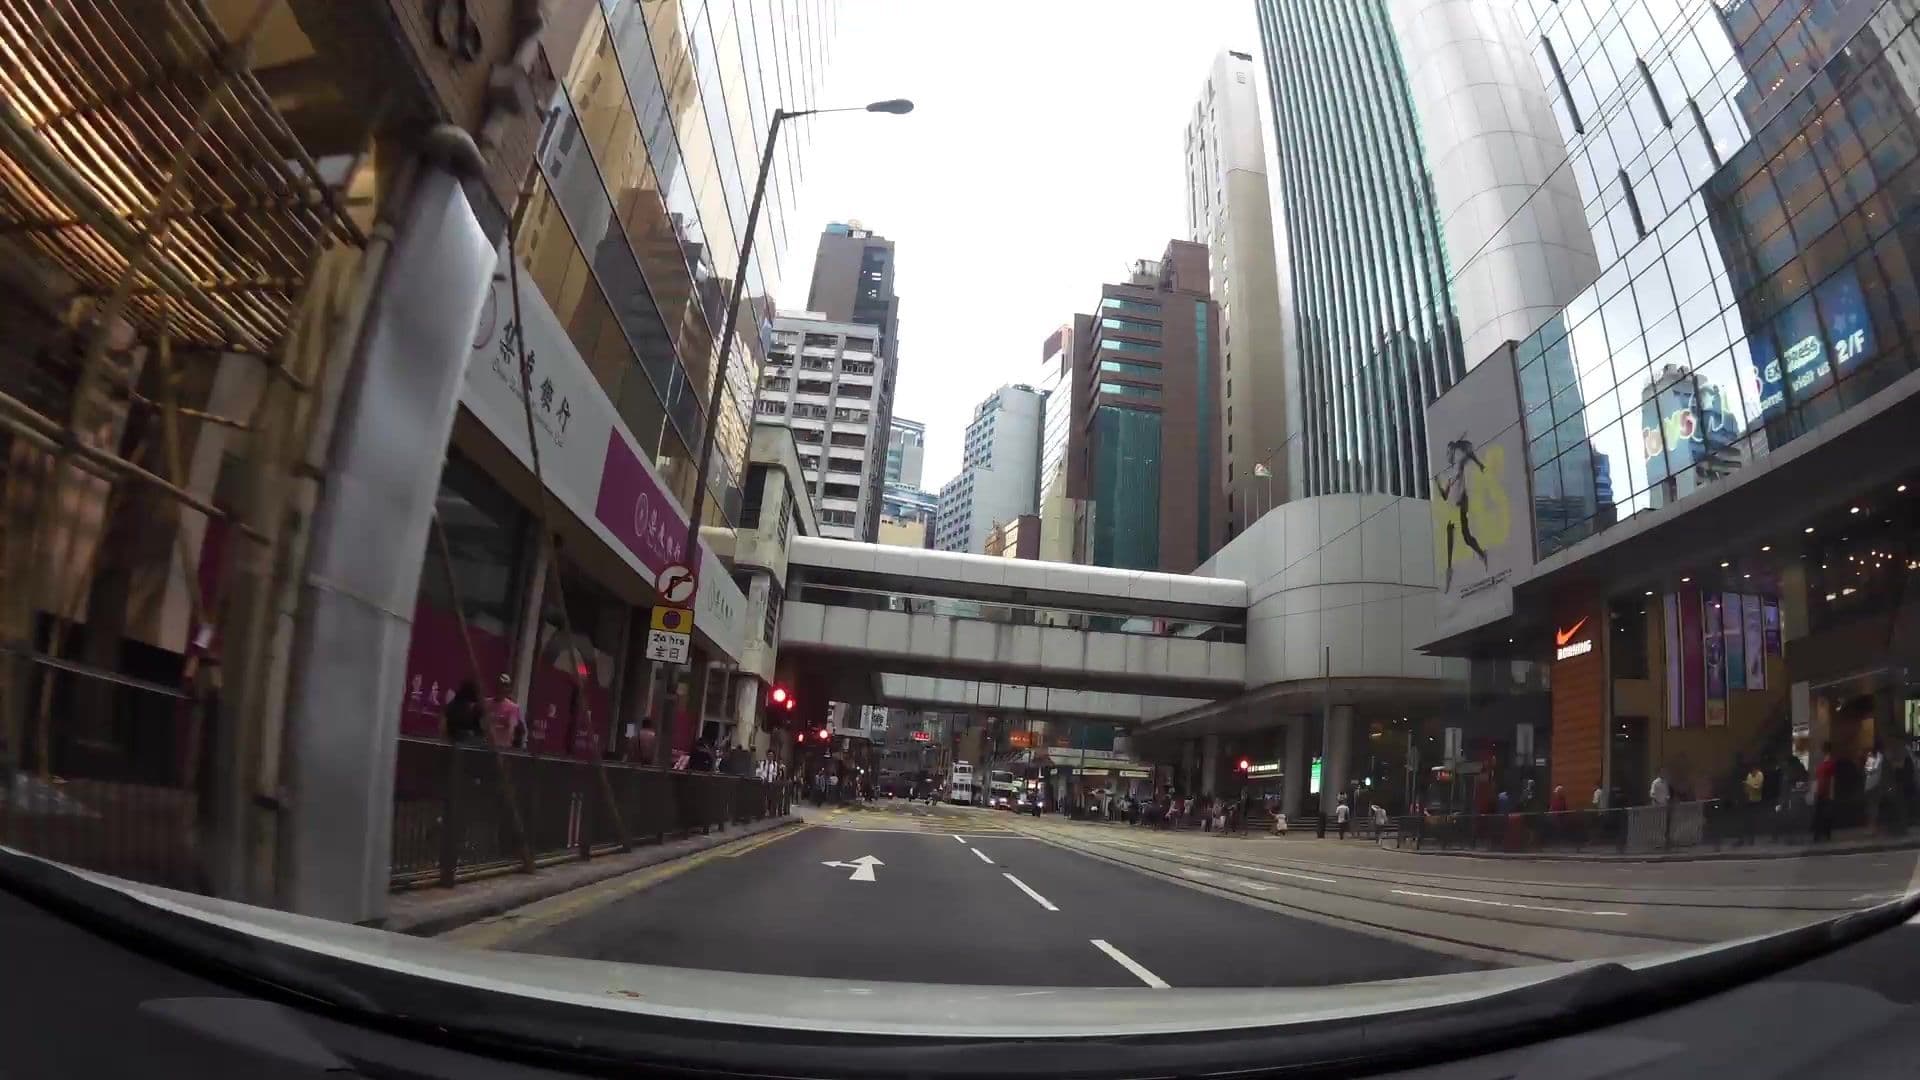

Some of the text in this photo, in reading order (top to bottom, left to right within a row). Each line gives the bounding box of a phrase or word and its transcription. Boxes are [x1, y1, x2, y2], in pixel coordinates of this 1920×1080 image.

[1835, 329, 1866, 365] 2/F
[653, 633, 685, 646] 24 hrs
